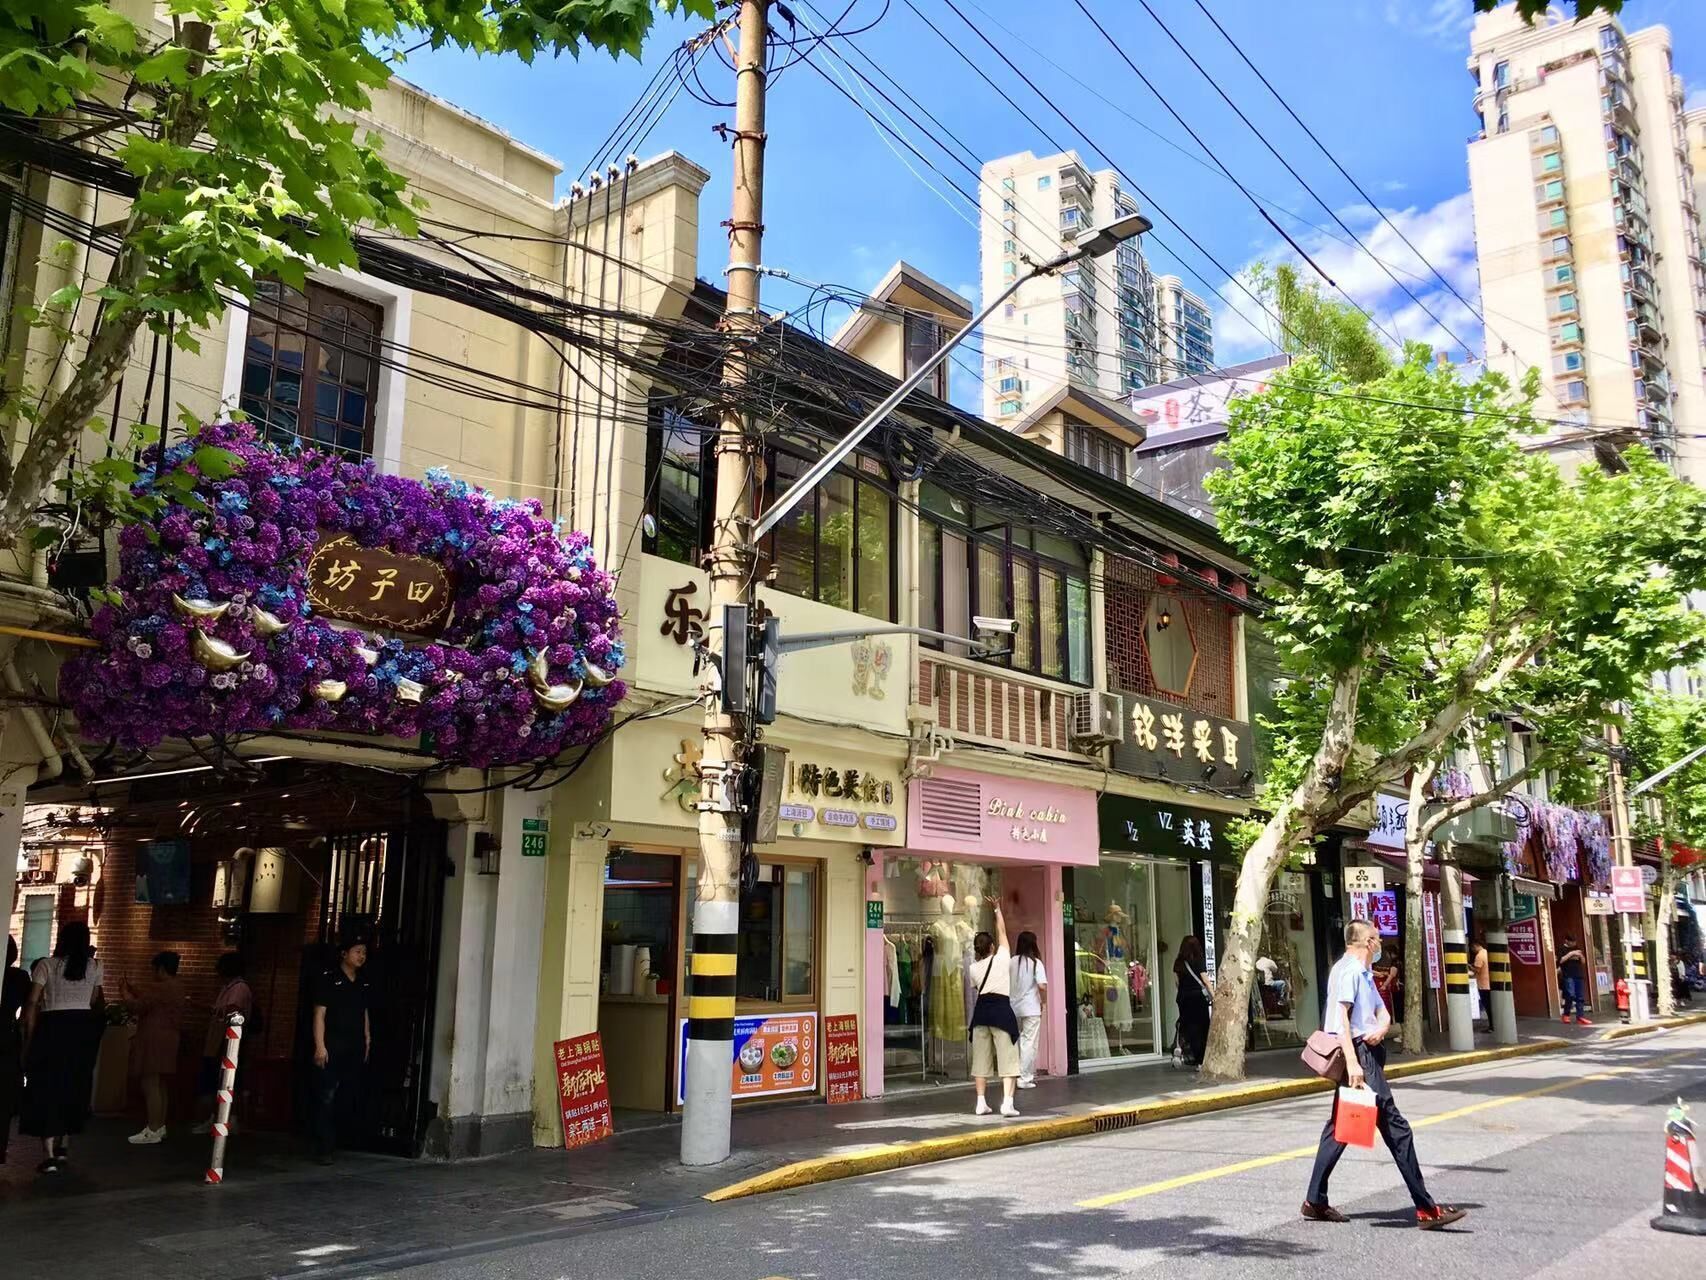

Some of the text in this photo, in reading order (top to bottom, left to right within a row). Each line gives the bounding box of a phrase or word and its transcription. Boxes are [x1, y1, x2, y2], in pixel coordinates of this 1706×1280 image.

[1132, 702, 1239, 770] 铭洋采耳
[1158, 811, 1173, 830] VZ
[524, 836, 544, 849] 246
[869, 902, 882, 913] 244
